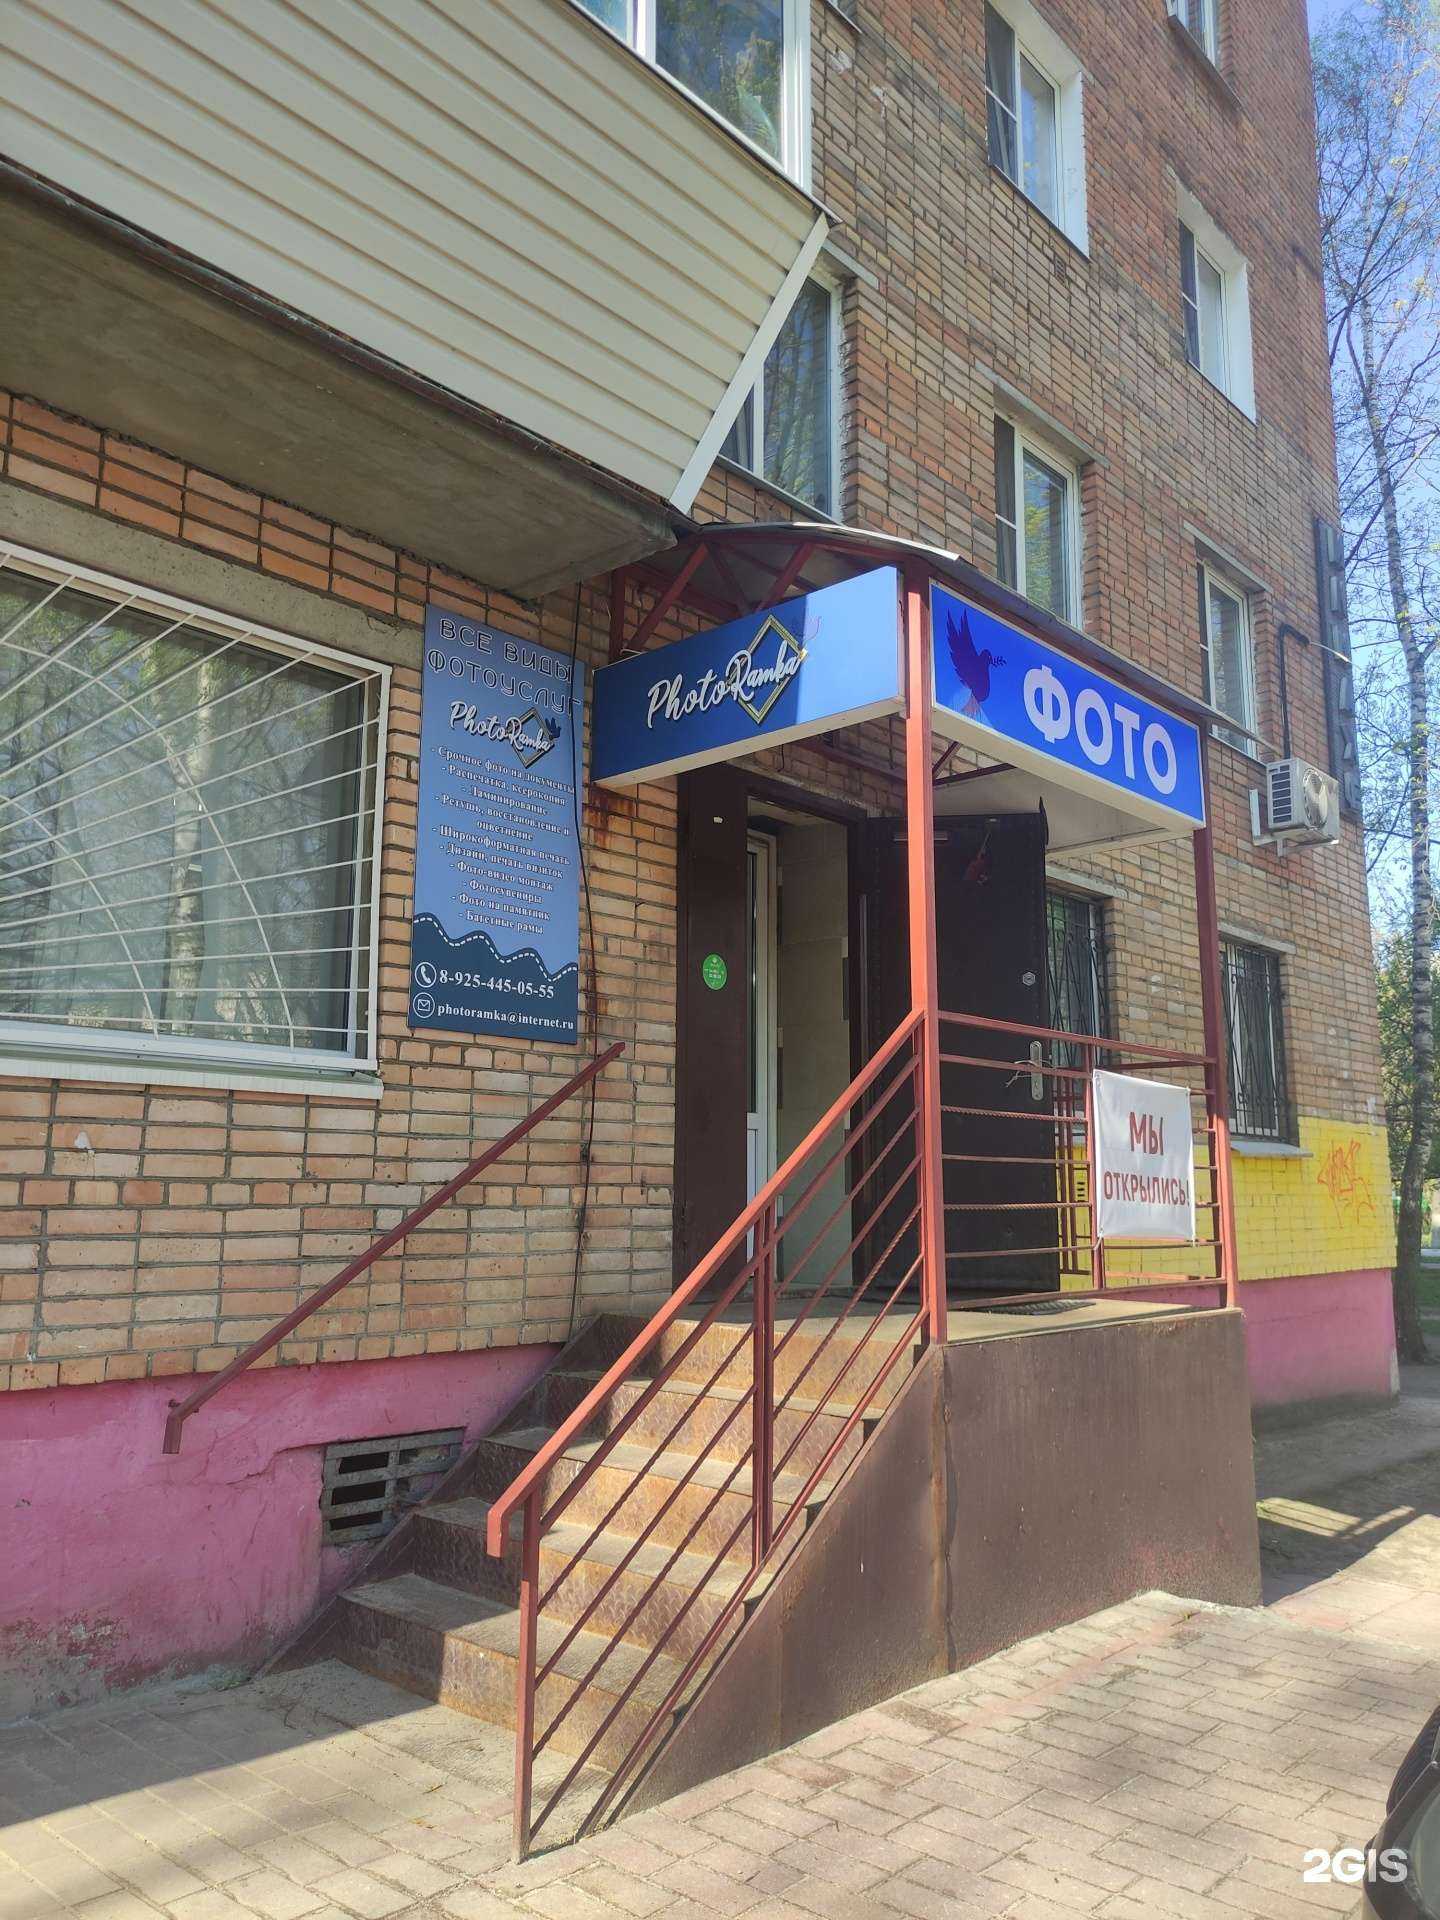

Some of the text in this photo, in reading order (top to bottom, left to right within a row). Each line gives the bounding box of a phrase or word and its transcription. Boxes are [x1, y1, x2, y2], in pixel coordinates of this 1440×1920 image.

[440, 618, 572, 686] ВСЕ ВИДЫ
[427, 649, 584, 720] ФОТОУСЛУГ
[647, 639, 803, 729] PhotoRamka
[1023, 664, 1177, 795] ФОТО
[438, 746, 575, 794] Срочное фото на документы
[469, 786, 548, 816] Ламинирование
[511, 782, 567, 807] ксерокопия
[490, 855, 524, 870] печать
[526, 863, 564, 879] визиток
[538, 849, 570, 866] печать
[469, 879, 545, 905] Фотосувениры
[518, 876, 553, 892] монтаж
[459, 893, 551, 922] Фото на памятник
[466, 910, 544, 935] Багетные рамы
[439, 969, 554, 999] 8-925-445-05-55
[437, 1004, 574, 1030] photoramka@internet.ru
[1129, 1111, 1164, 1155] МЫ
[1103, 1170, 1190, 1206] ОТКРЫЛИСЬ!
